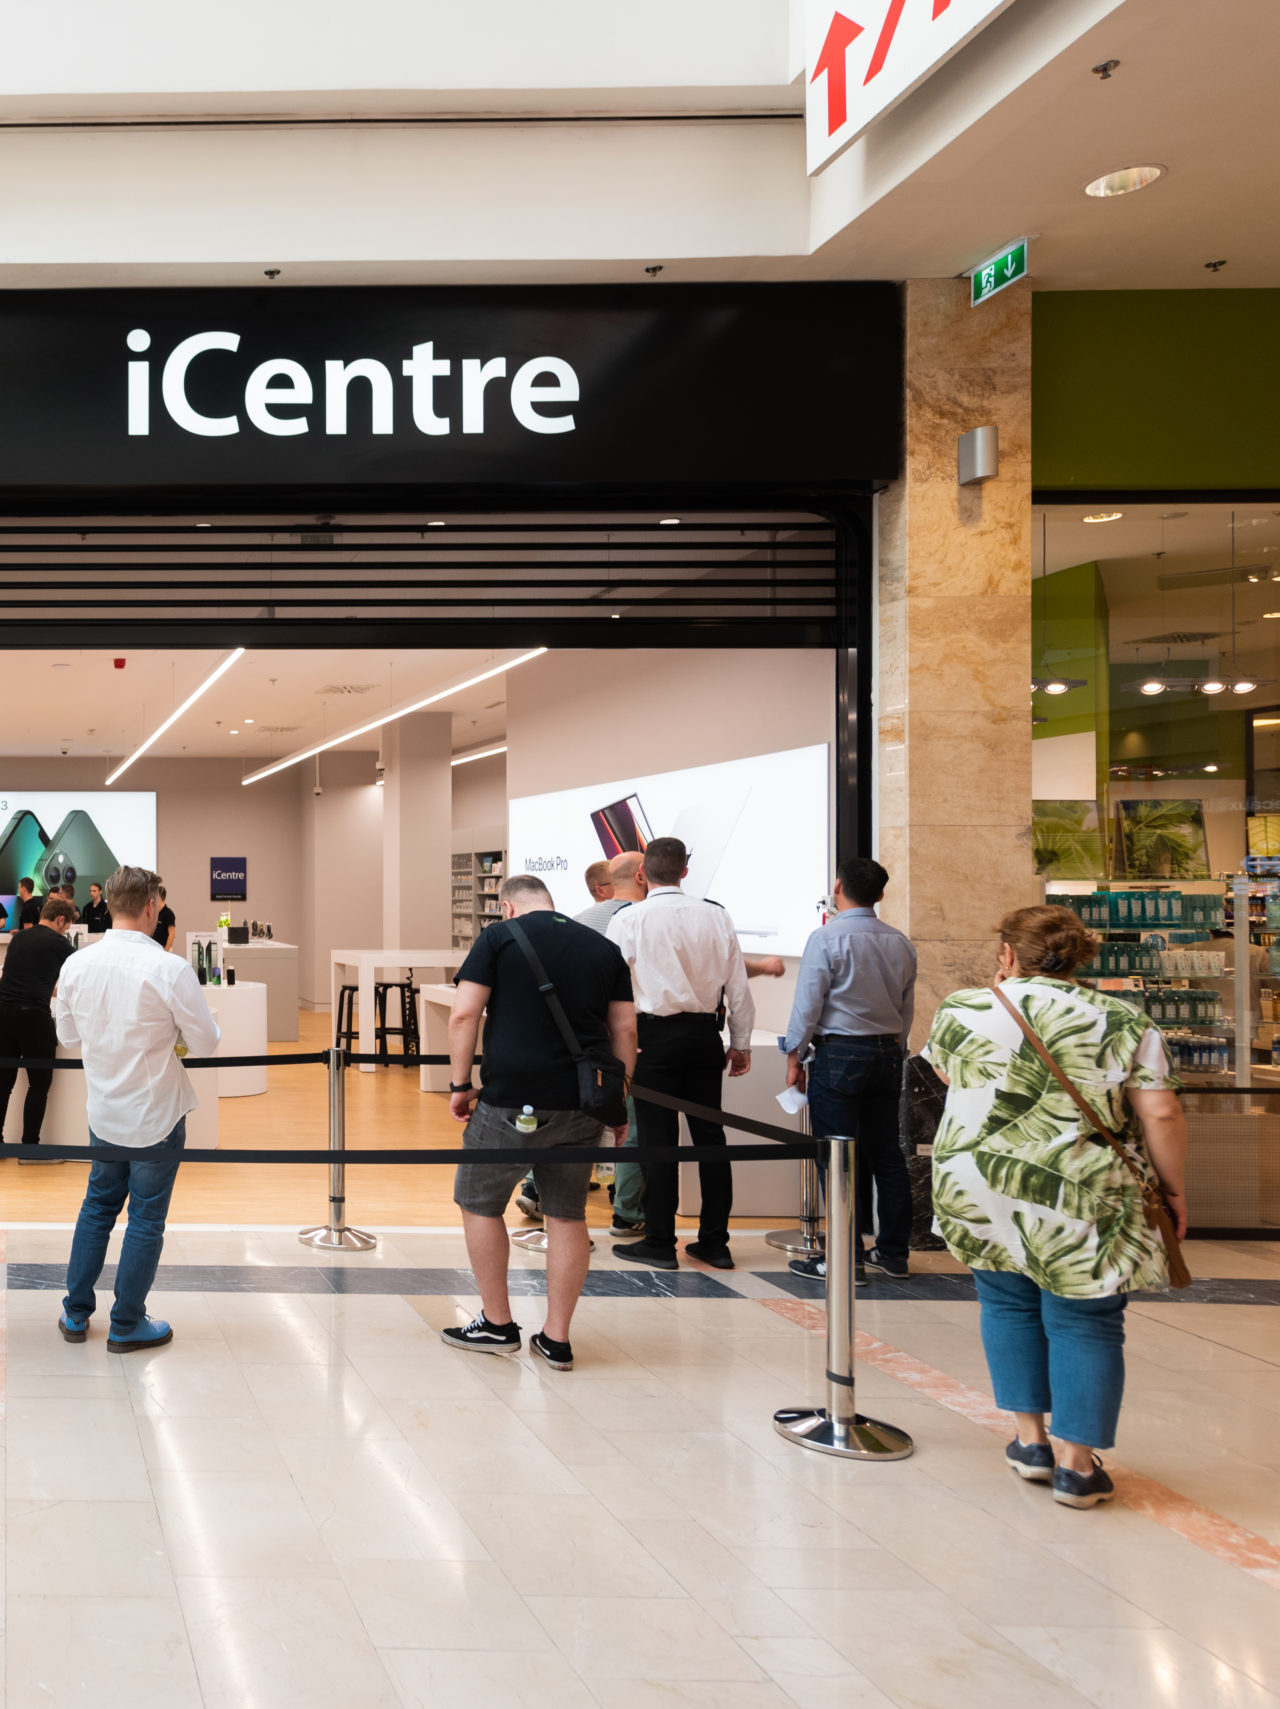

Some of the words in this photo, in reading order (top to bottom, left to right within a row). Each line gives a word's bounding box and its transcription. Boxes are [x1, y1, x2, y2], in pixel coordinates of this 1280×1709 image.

[126, 328, 580, 437] iCentre
[525, 857, 556, 872] MacBook
[556, 856, 569, 871] Pro
[212, 870, 245, 880] iCentre
